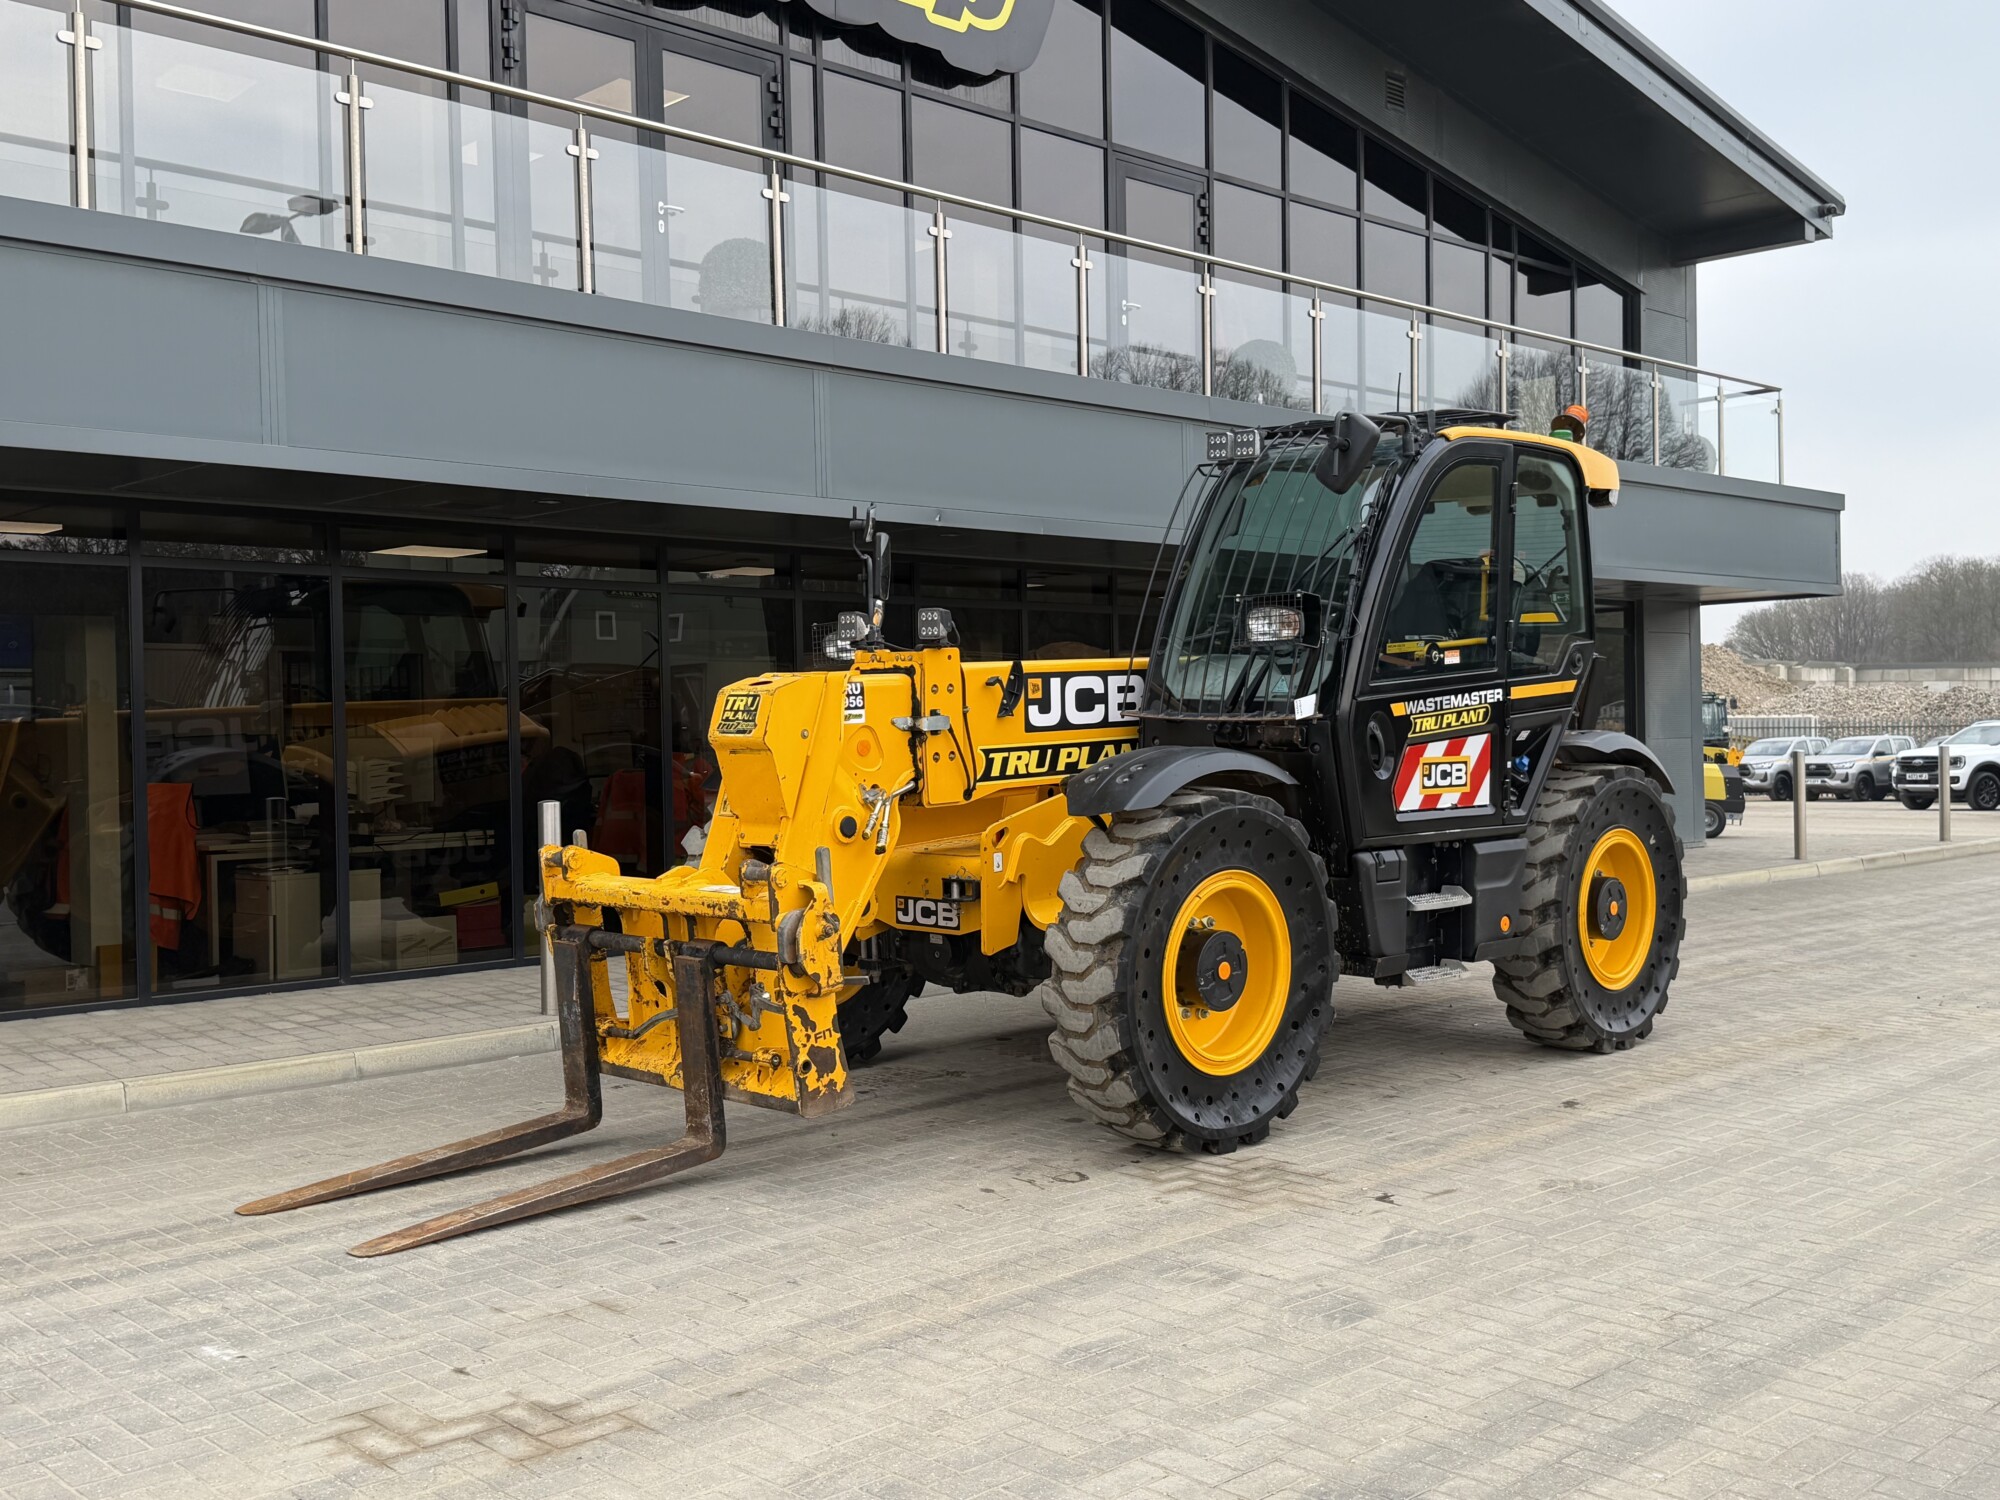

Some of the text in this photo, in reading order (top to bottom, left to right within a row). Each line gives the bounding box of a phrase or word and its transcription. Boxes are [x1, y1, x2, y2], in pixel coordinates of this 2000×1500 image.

[725, 696, 760, 711] TRU
[1028, 675, 1146, 728] JCB
[1405, 688, 1503, 715] WASTEMASTER
[1414, 708, 1487, 733] TRU PLANT
[989, 749, 1053, 777] TRU
[1423, 763, 1468, 787] JCB
[897, 899, 960, 928] JCB
